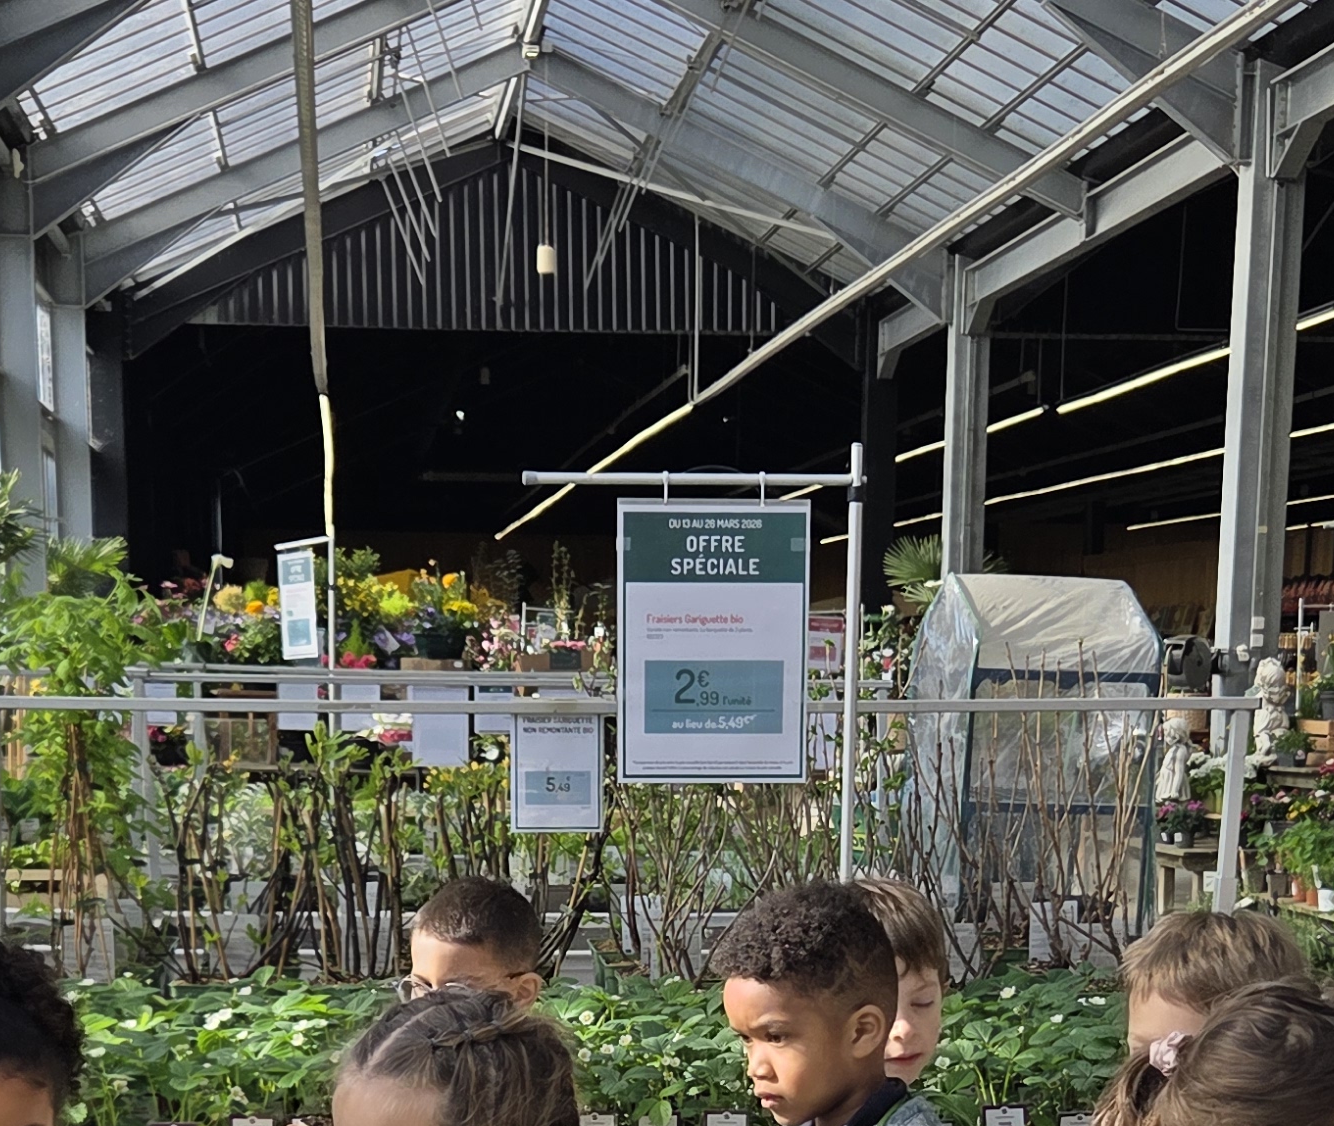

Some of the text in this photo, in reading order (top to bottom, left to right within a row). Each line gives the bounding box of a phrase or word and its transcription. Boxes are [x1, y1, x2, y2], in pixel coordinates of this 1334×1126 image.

[668, 518, 681, 529] DU
[692, 518, 704, 529] AU
[717, 518, 740, 529] MARS
[686, 535, 745, 553] OFFRE
[670, 554, 760, 575] SPÉCIALE
[646, 613, 744, 626] Fraisiers Gariguette bio
[722, 695, 752, 707] l'unité
[672, 720, 684, 729] au
[685, 718, 703, 729] lieu
[704, 718, 717, 729] de
[522, 726, 537, 734] NON
[582, 726, 594, 734] BIO
